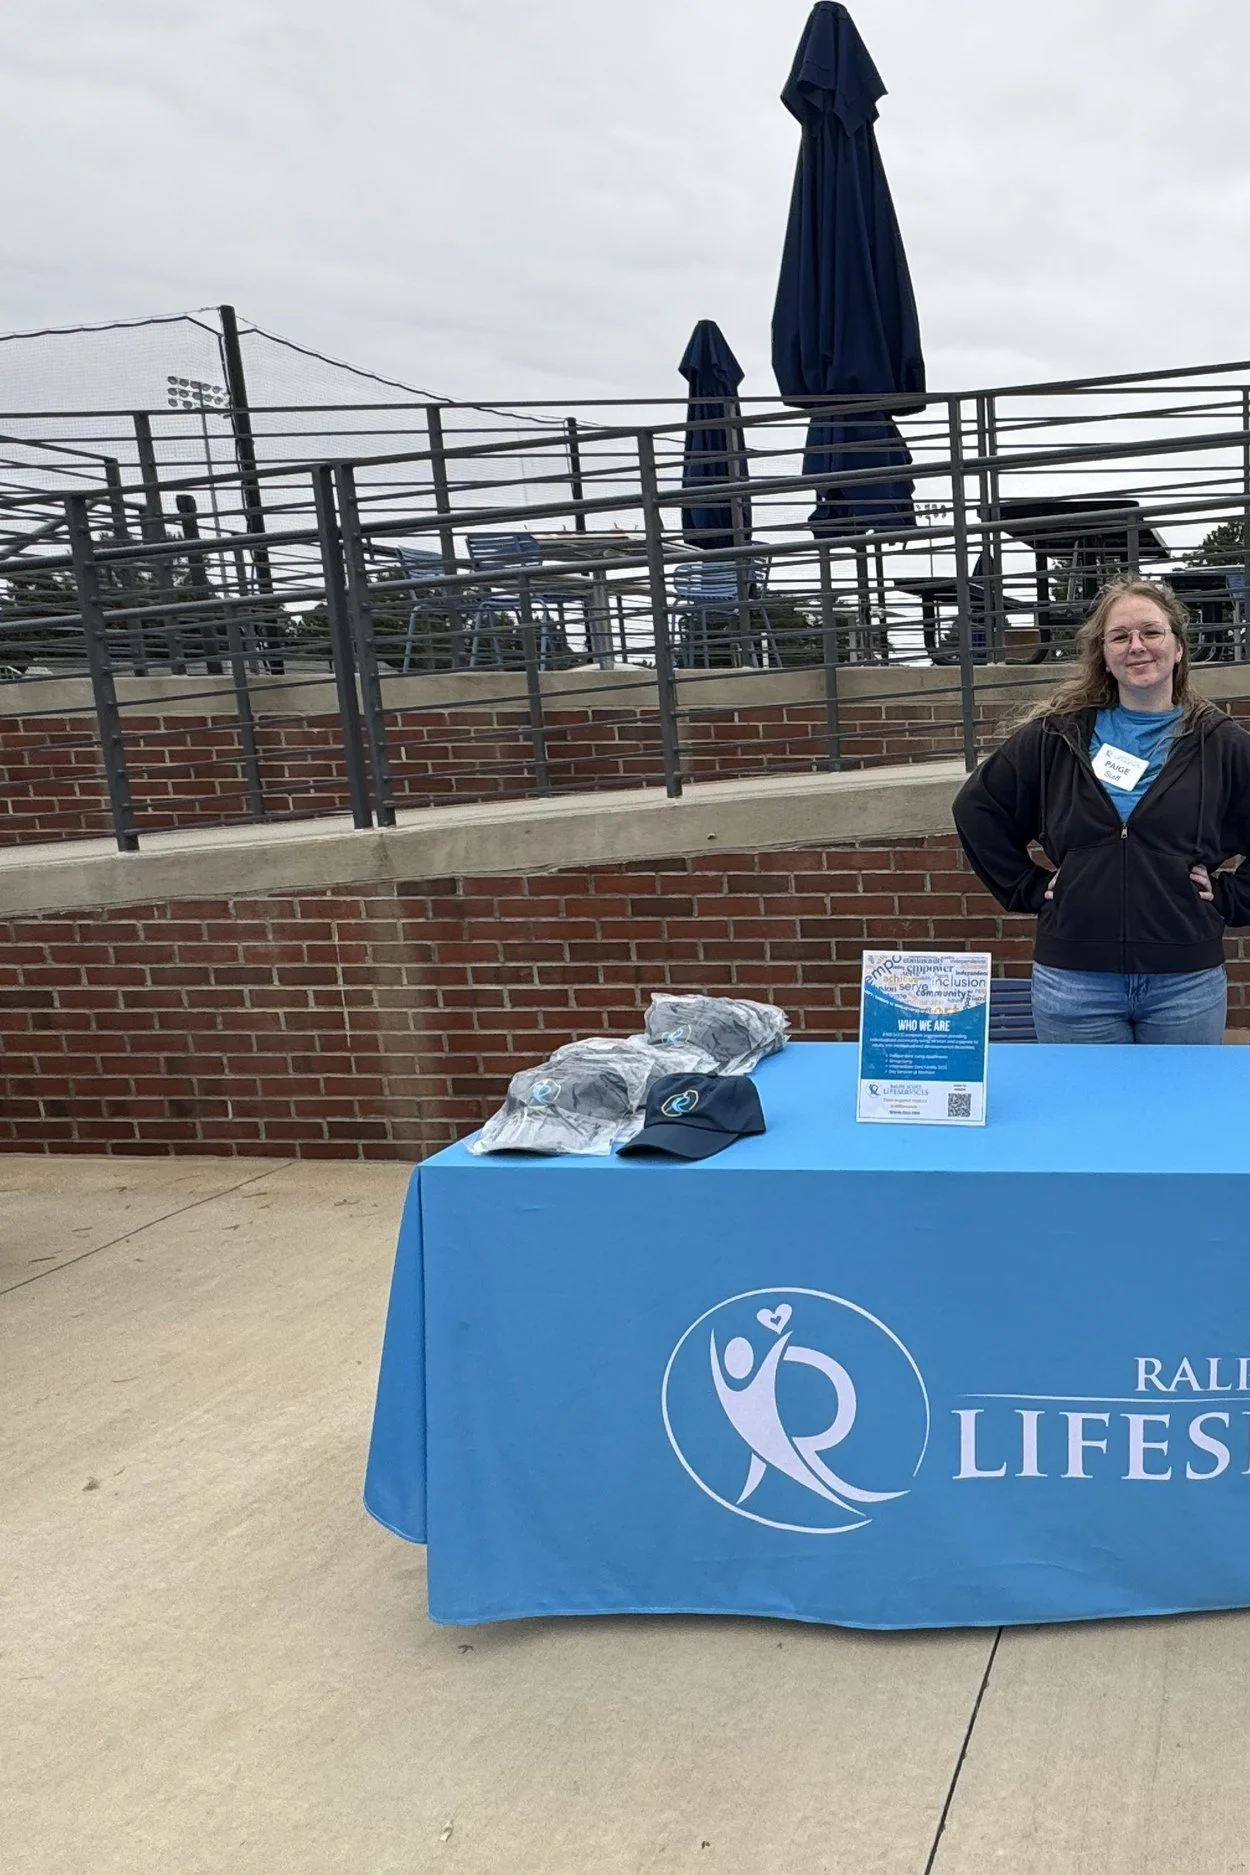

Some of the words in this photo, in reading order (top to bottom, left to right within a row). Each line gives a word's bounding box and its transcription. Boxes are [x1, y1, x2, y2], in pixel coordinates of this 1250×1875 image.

[1104, 760, 1131, 776] PAIGE
[899, 983, 929, 992] serve
[931, 975, 986, 988] inclusion
[916, 989, 968, 1000] community
[897, 1019, 918, 1031] WHO
[919, 1020, 933, 1032] WE
[933, 1020, 951, 1032] ARE
